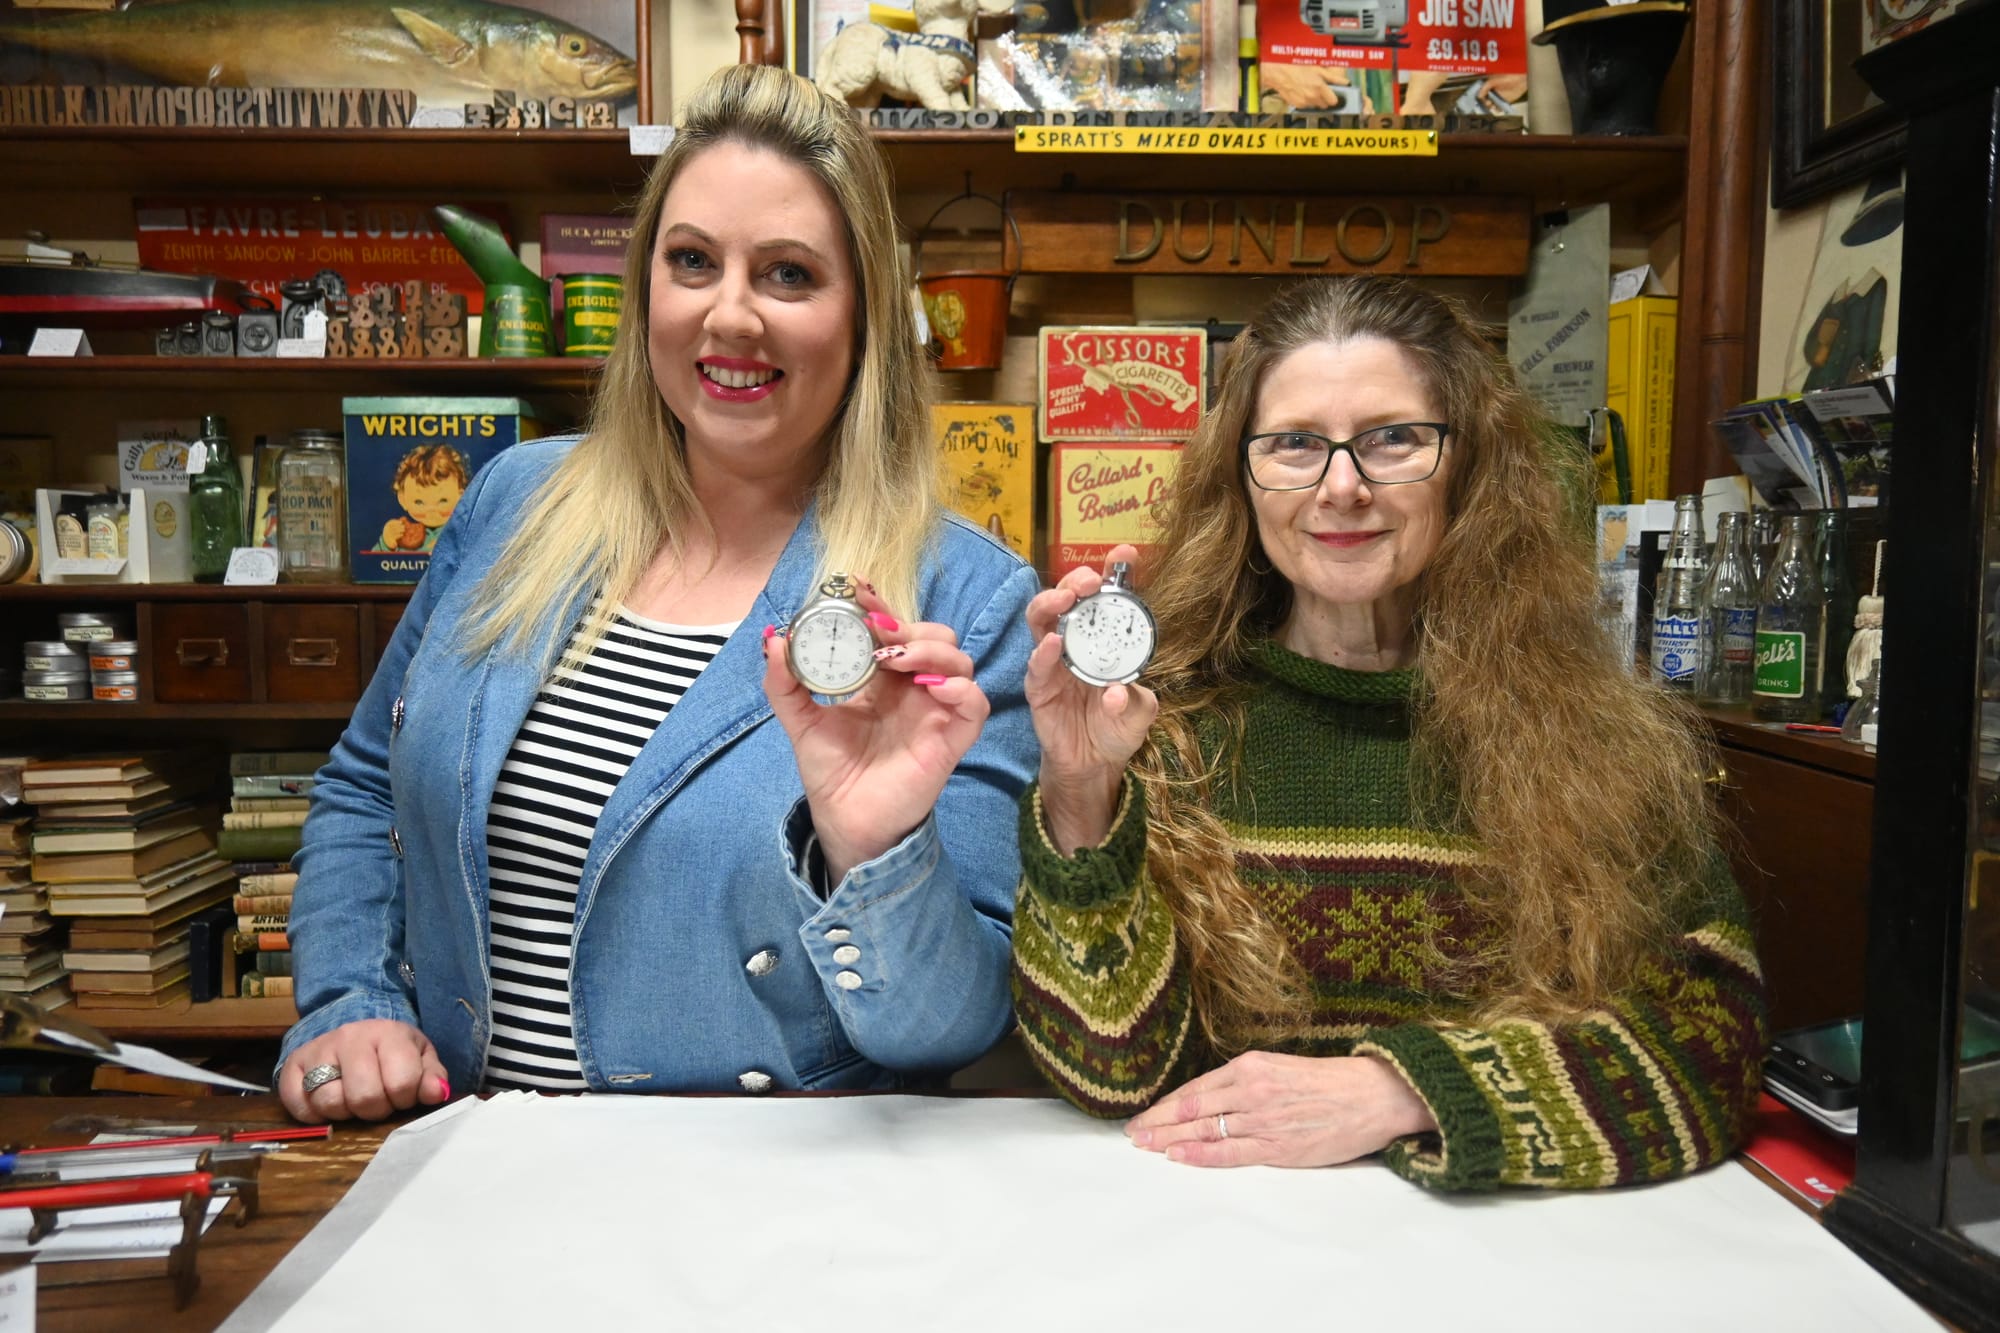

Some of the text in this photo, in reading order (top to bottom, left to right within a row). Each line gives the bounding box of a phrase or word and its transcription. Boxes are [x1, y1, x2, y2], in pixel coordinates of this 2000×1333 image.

[1418, 0, 1513, 29] JIG SAW
[1427, 38, 1499, 62] £9.19.6
[1036, 130, 1124, 149] SPRATT'S
[1138, 131, 1200, 149] MIXED
[1208, 131, 1267, 149] OVALS
[1113, 200, 1451, 267] DUNLOP
[1050, 384, 1086, 400] SPECIAL
[1115, 366, 1192, 400] CIGARETTES
[1050, 401, 1087, 419] QUALITY
[1054, 393, 1081, 407] ARMY
[362, 415, 497, 438] WRIGHTS
[1067, 456, 1142, 494] Callard
[1078, 493, 1140, 523] Bowser
[1757, 678, 1790, 688] DRINKS
[251, 915, 288, 924] ARTHU
